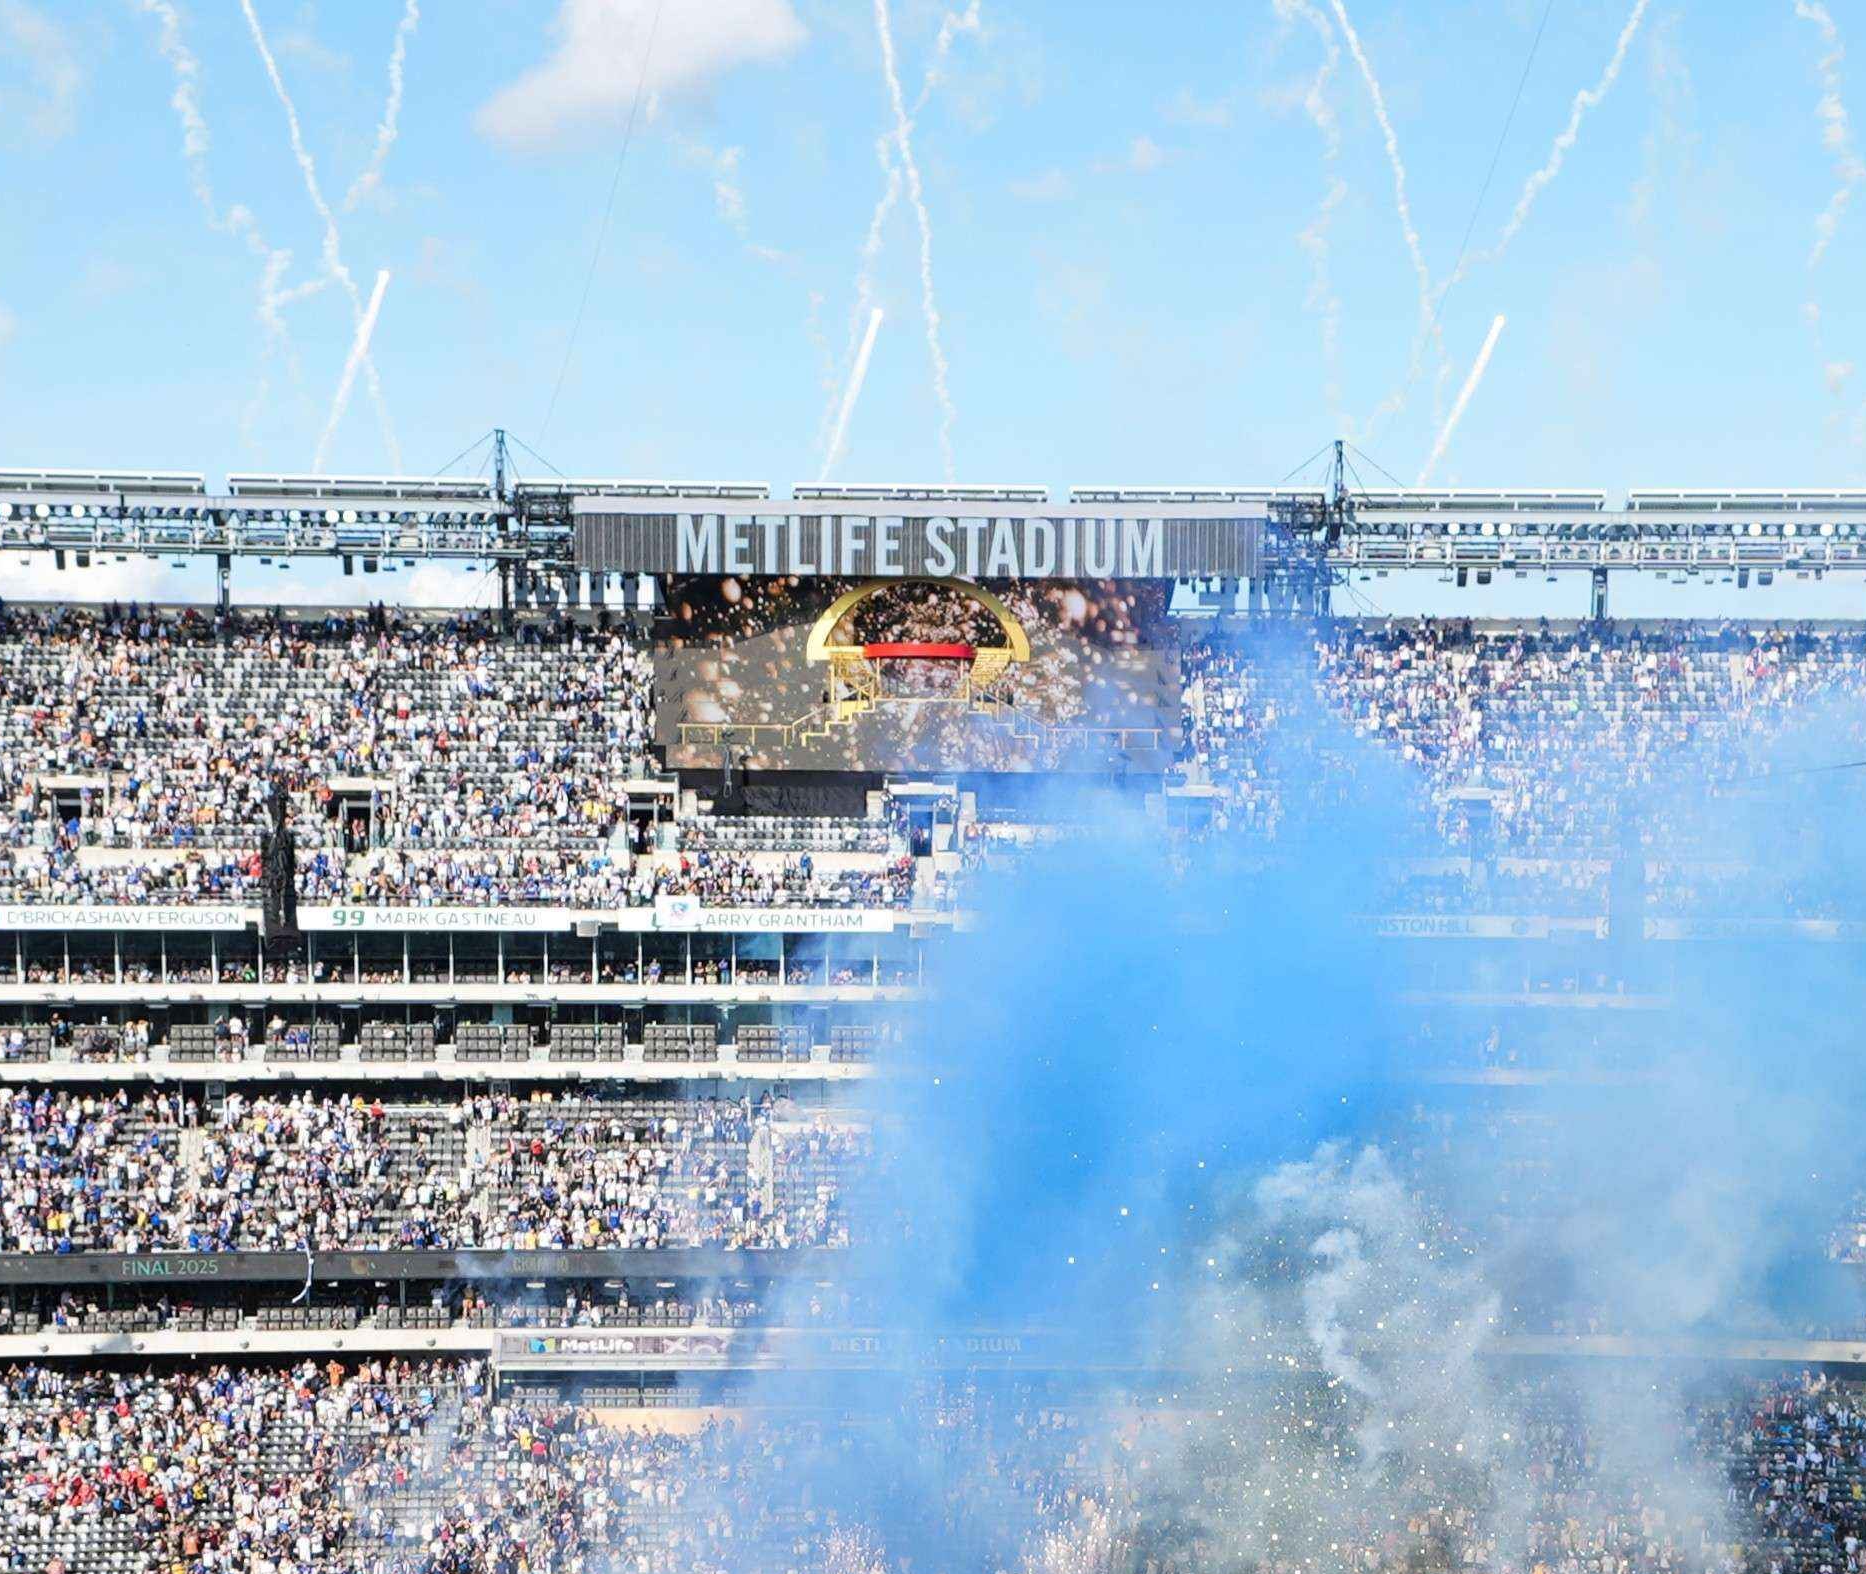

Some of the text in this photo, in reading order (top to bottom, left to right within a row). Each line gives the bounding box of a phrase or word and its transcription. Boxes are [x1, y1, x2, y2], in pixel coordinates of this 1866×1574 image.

[675, 513, 1163, 577] METLIFE STADIUM
[147, 910, 239, 925] FERGUSON
[332, 910, 536, 926] 99 MARK GASTINEAU
[704, 913, 863, 928] ARRY GRANTHAM
[122, 1259, 219, 1275] FINAL 2025
[561, 1339, 634, 1352] MetLife
